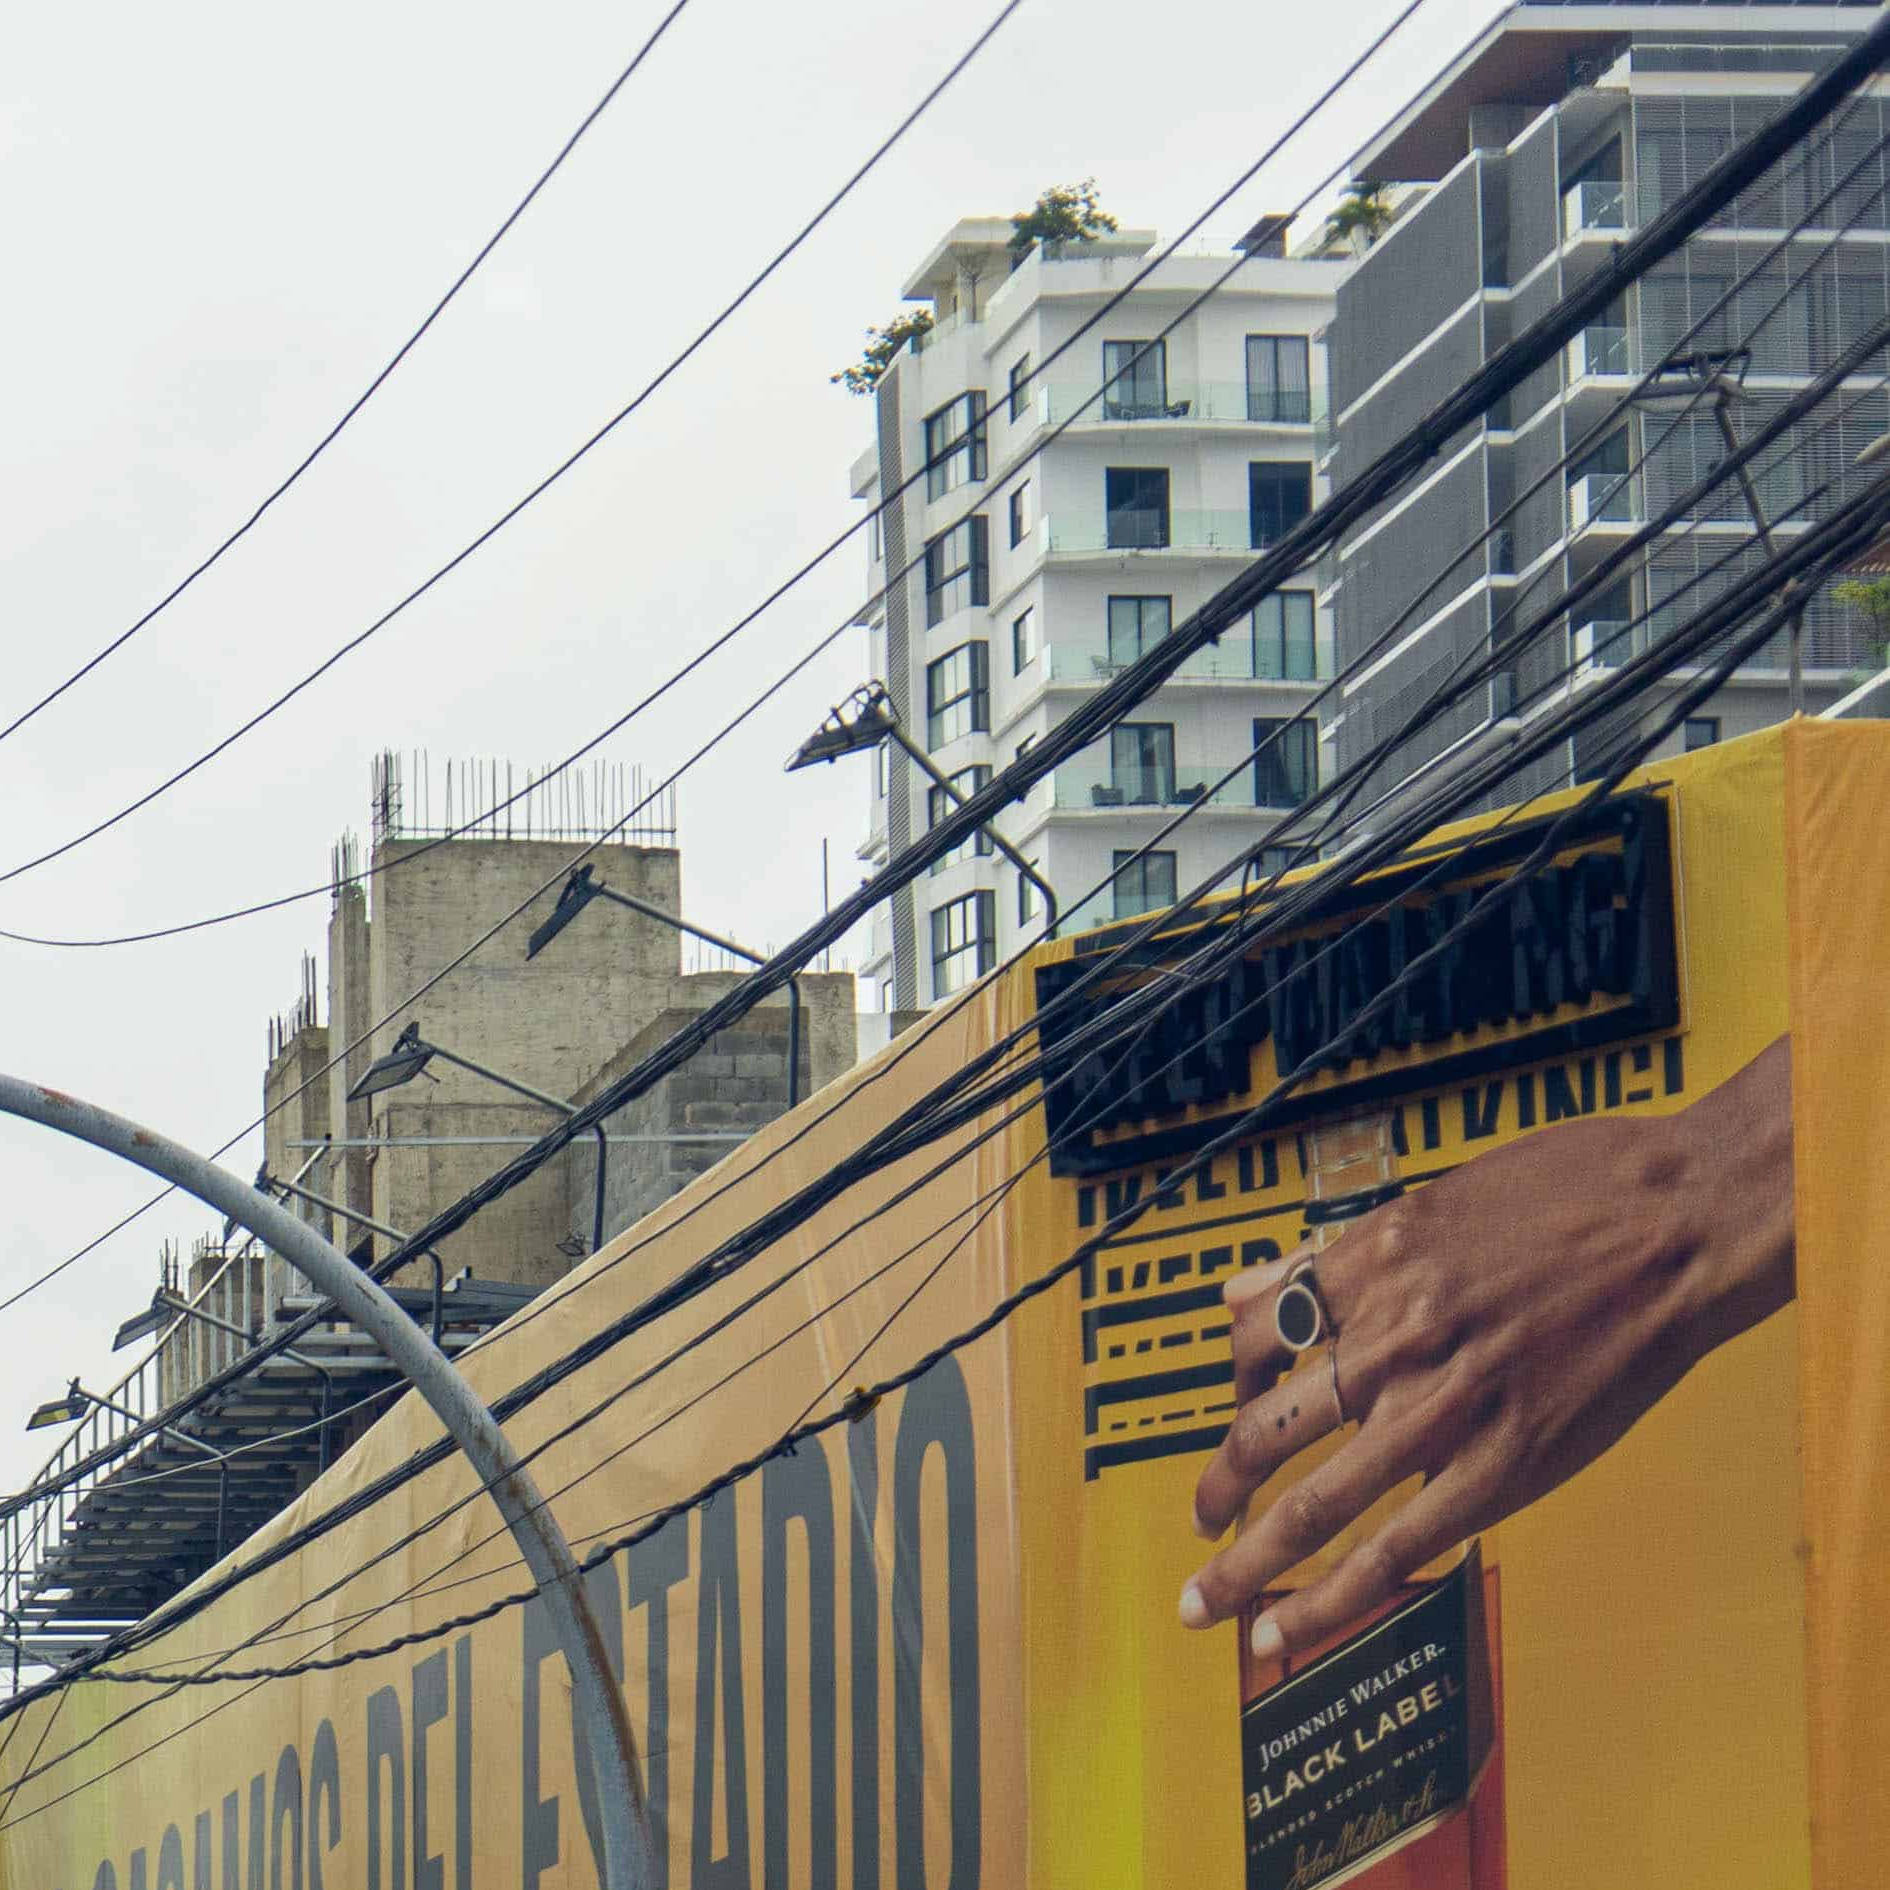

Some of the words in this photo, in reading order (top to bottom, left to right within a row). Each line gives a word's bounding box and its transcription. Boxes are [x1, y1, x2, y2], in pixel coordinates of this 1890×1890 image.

[1247, 1740, 1347, 1819] BLACK
[1354, 1674, 1460, 1753] LABEL
[1259, 1698, 1348, 1772] JOHNNIE
[1350, 1642, 1440, 1705] WALKER
